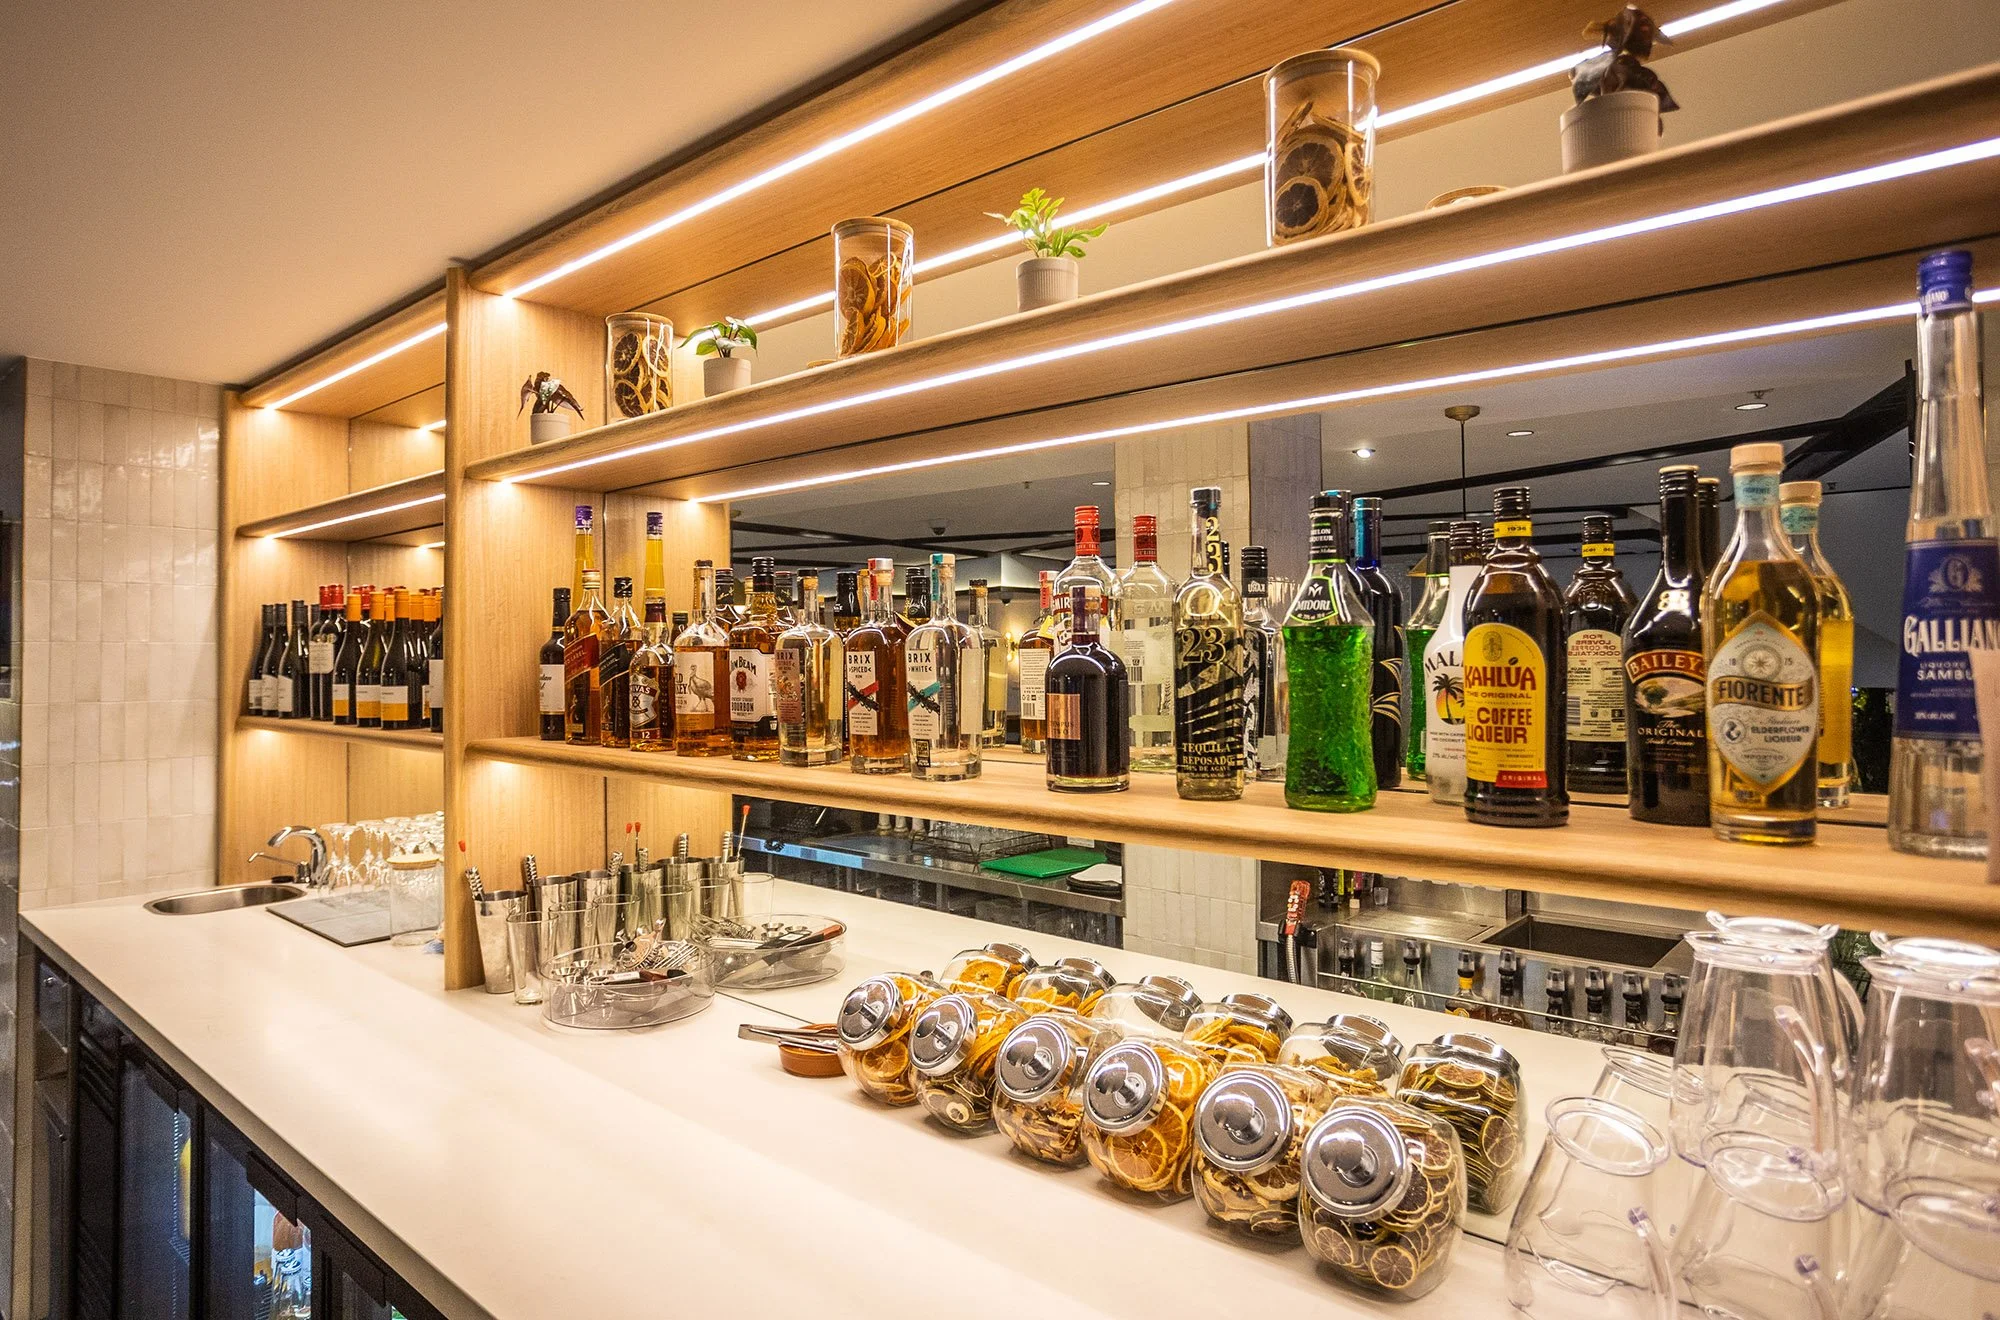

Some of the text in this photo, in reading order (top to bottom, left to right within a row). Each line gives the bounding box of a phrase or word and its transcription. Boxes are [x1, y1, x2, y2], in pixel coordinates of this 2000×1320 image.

[1052, 597, 1070, 609] SMIR
[1295, 599, 1331, 612] MIDORI
[1903, 615, 2000, 658] GALLIAN
[1181, 626, 1226, 664] 23
[848, 654, 870, 664] BRIX
[908, 653, 931, 663] BRIX
[1425, 651, 1463, 678] MAL
[1917, 669, 1974, 681] SAMBU
[1719, 681, 1805, 706] FIORENTE
[731, 701, 754, 712] BOURBON
[1476, 707, 1532, 725] COFFEE
[641, 731, 650, 739] 12
[1467, 724, 1528, 744] LIQUEUR
[1637, 727, 1705, 737] ORIGINAL
[1751, 726, 1810, 734] ELDERFLOWER
[1764, 735, 1802, 743] LIQUEUR
[1182, 742, 1231, 755] TEQUILA
